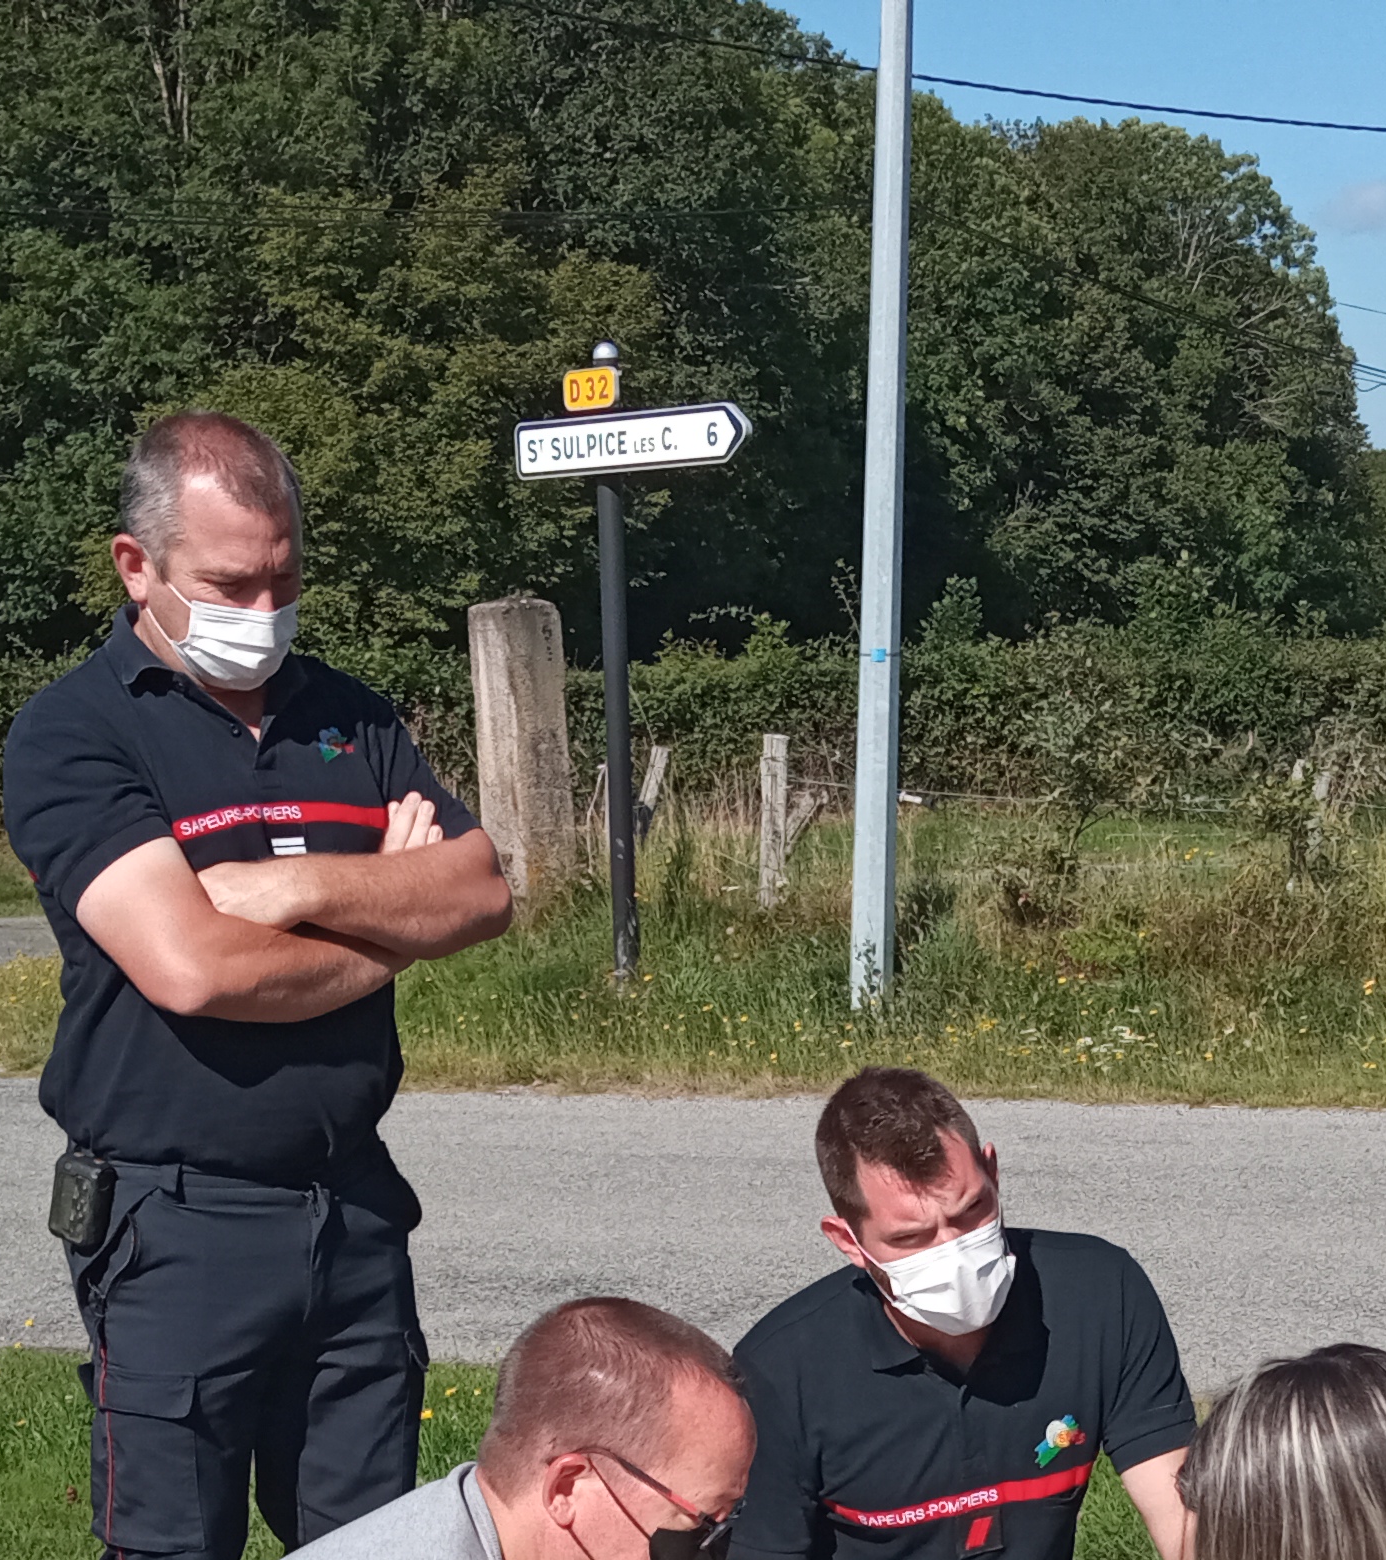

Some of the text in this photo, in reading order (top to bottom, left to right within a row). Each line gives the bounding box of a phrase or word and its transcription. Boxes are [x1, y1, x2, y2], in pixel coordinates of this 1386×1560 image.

[550, 430, 628, 461] SULPICE
[633, 437, 655, 454] LES
[661, 426, 678, 451] C.
[706, 421, 718, 447] 6
